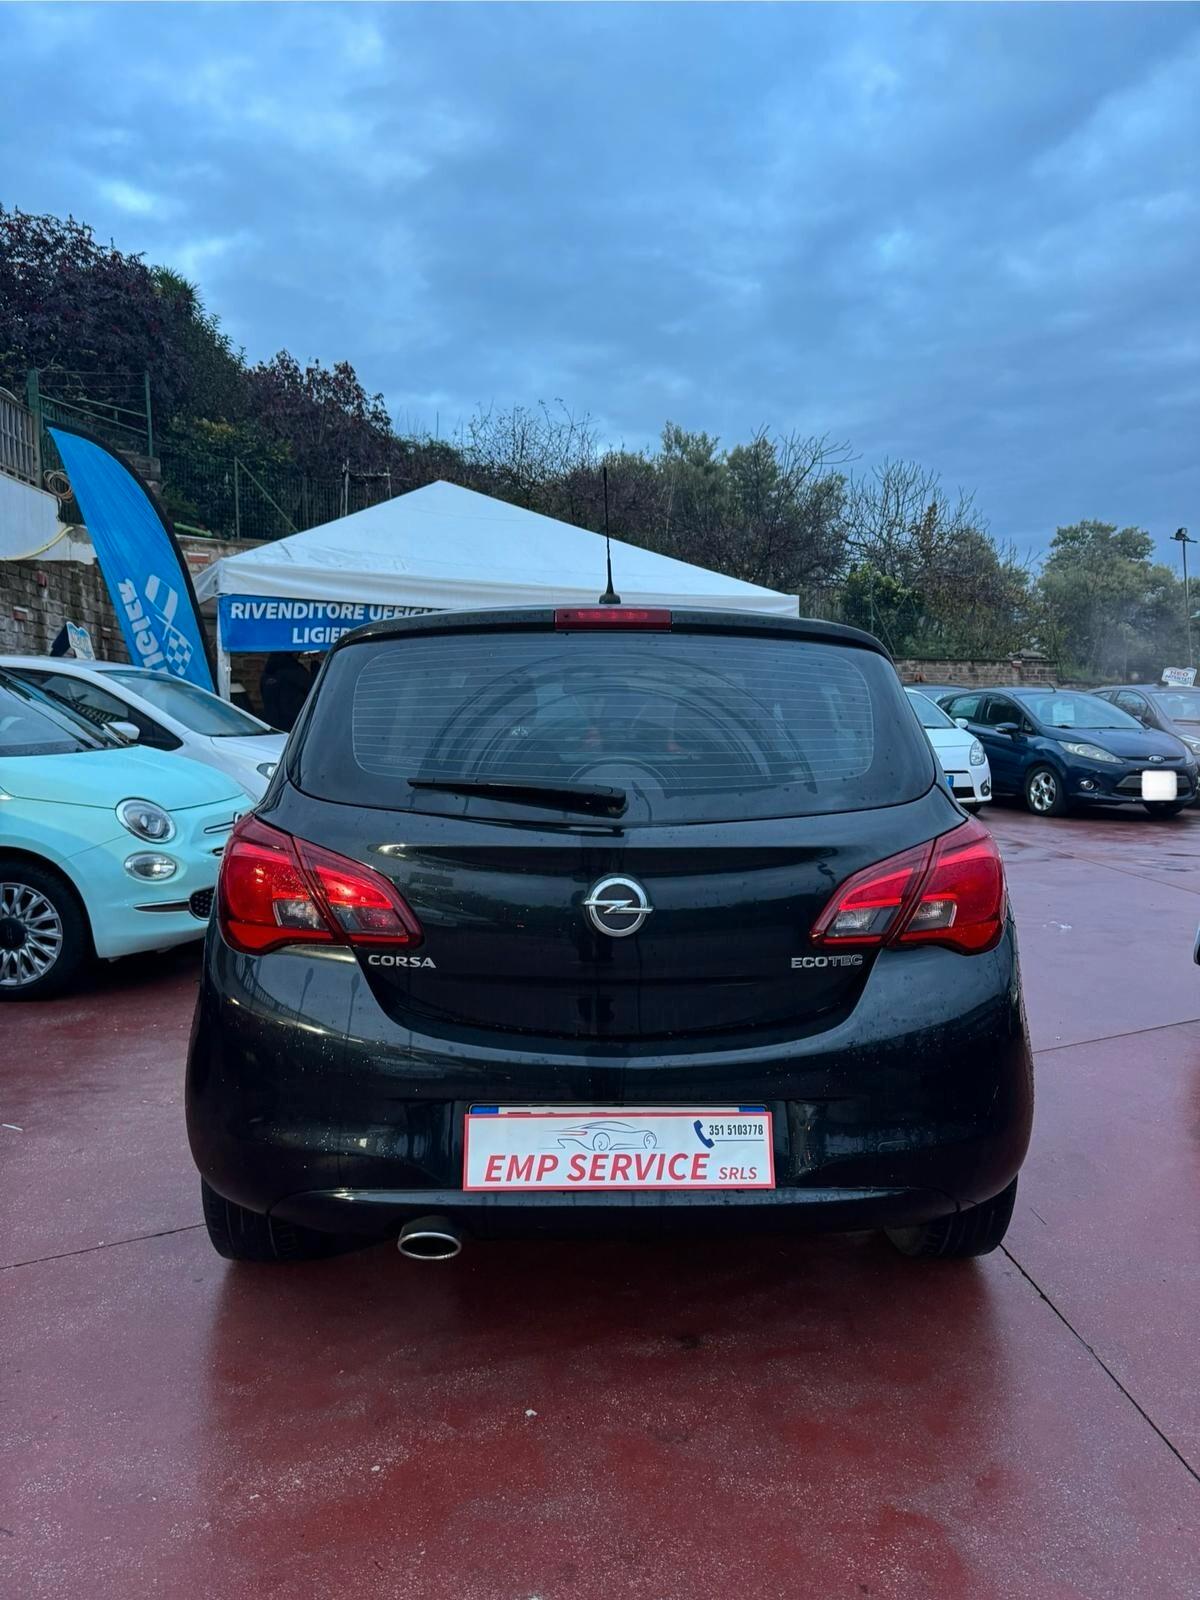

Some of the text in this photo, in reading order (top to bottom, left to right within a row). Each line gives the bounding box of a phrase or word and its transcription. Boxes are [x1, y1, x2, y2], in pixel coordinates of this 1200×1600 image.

[230, 602, 364, 620] RIVENDITORE
[367, 954, 437, 968] CORSA
[791, 954, 863, 969] ECOTEC
[709, 1124, 764, 1136] 351 5103778
[484, 1152, 757, 1182] EMP SERVICE SRLS
